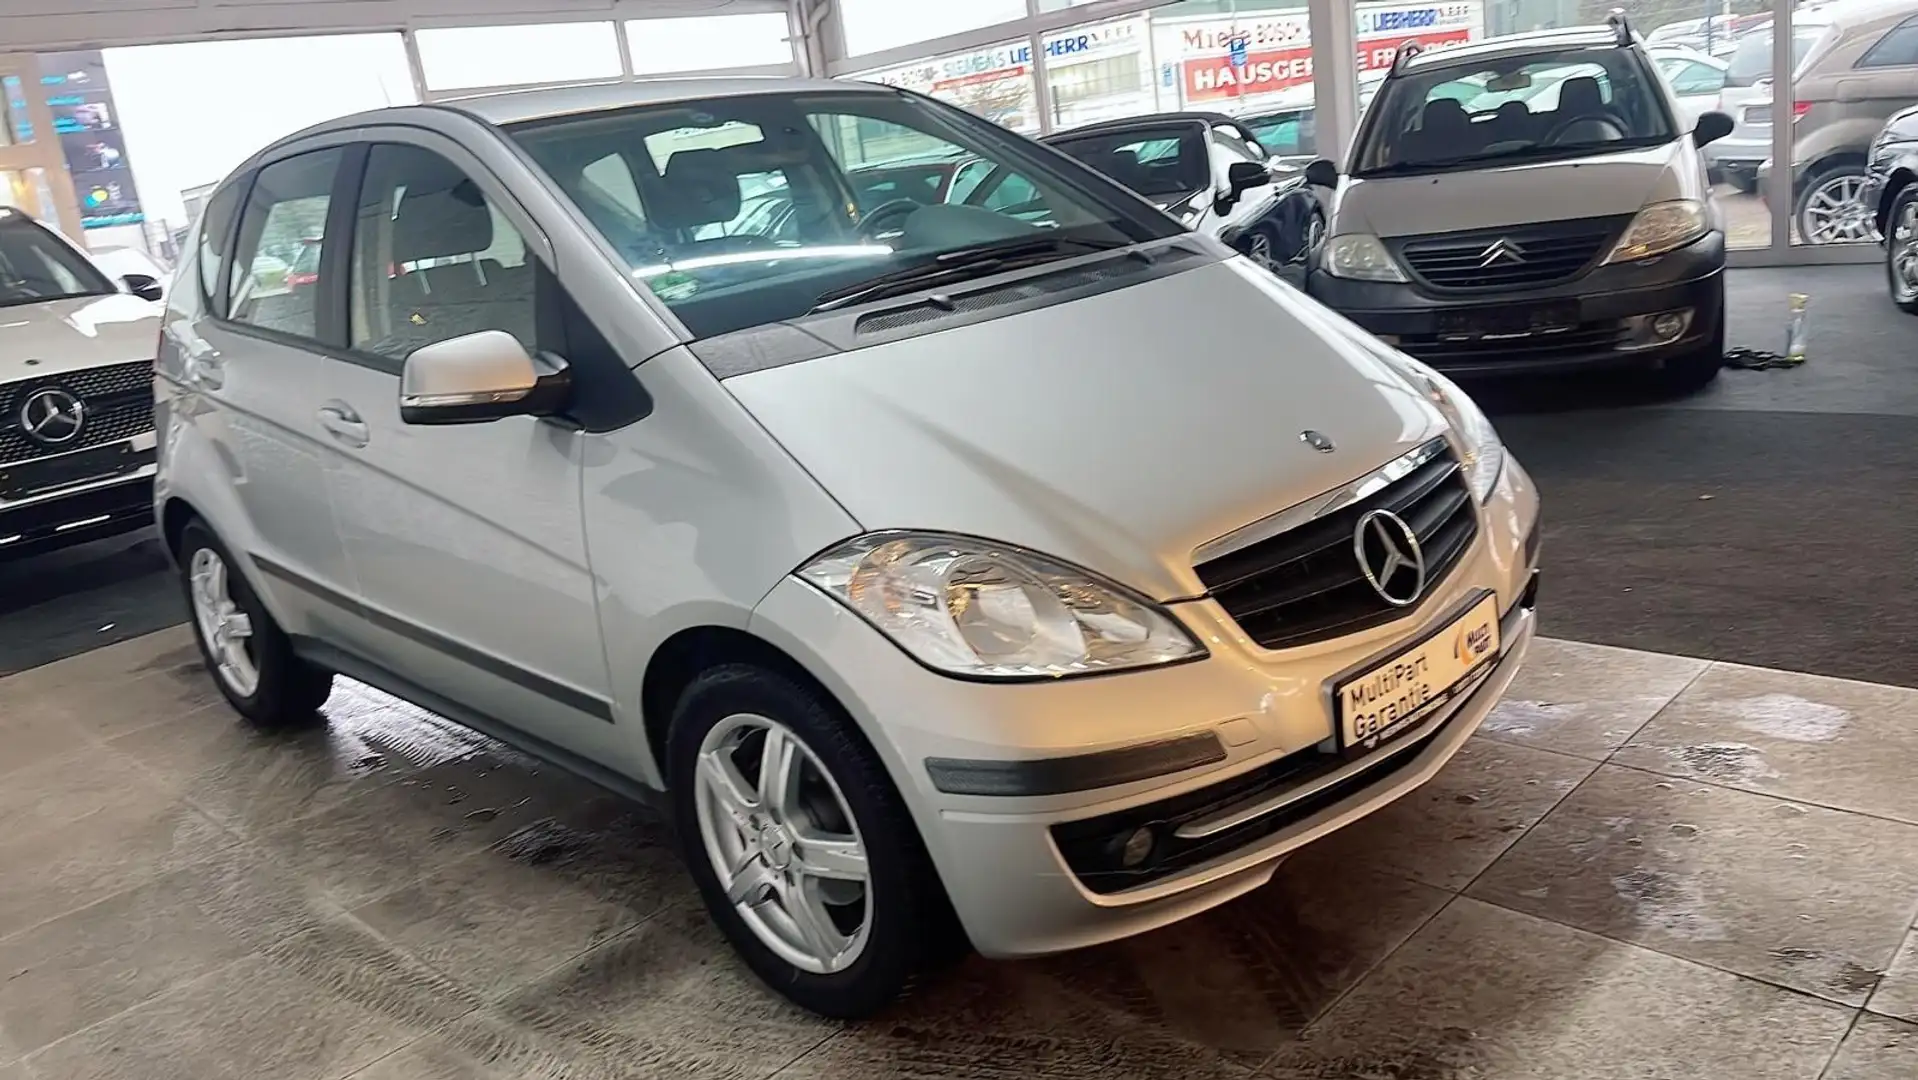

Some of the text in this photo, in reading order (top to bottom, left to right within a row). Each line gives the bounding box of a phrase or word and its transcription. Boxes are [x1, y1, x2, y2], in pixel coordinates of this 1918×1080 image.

[1009, 34, 1089, 64] LIEHERR
[1350, 655, 1428, 712] MultiPart
[1353, 681, 1431, 738] Garantie
